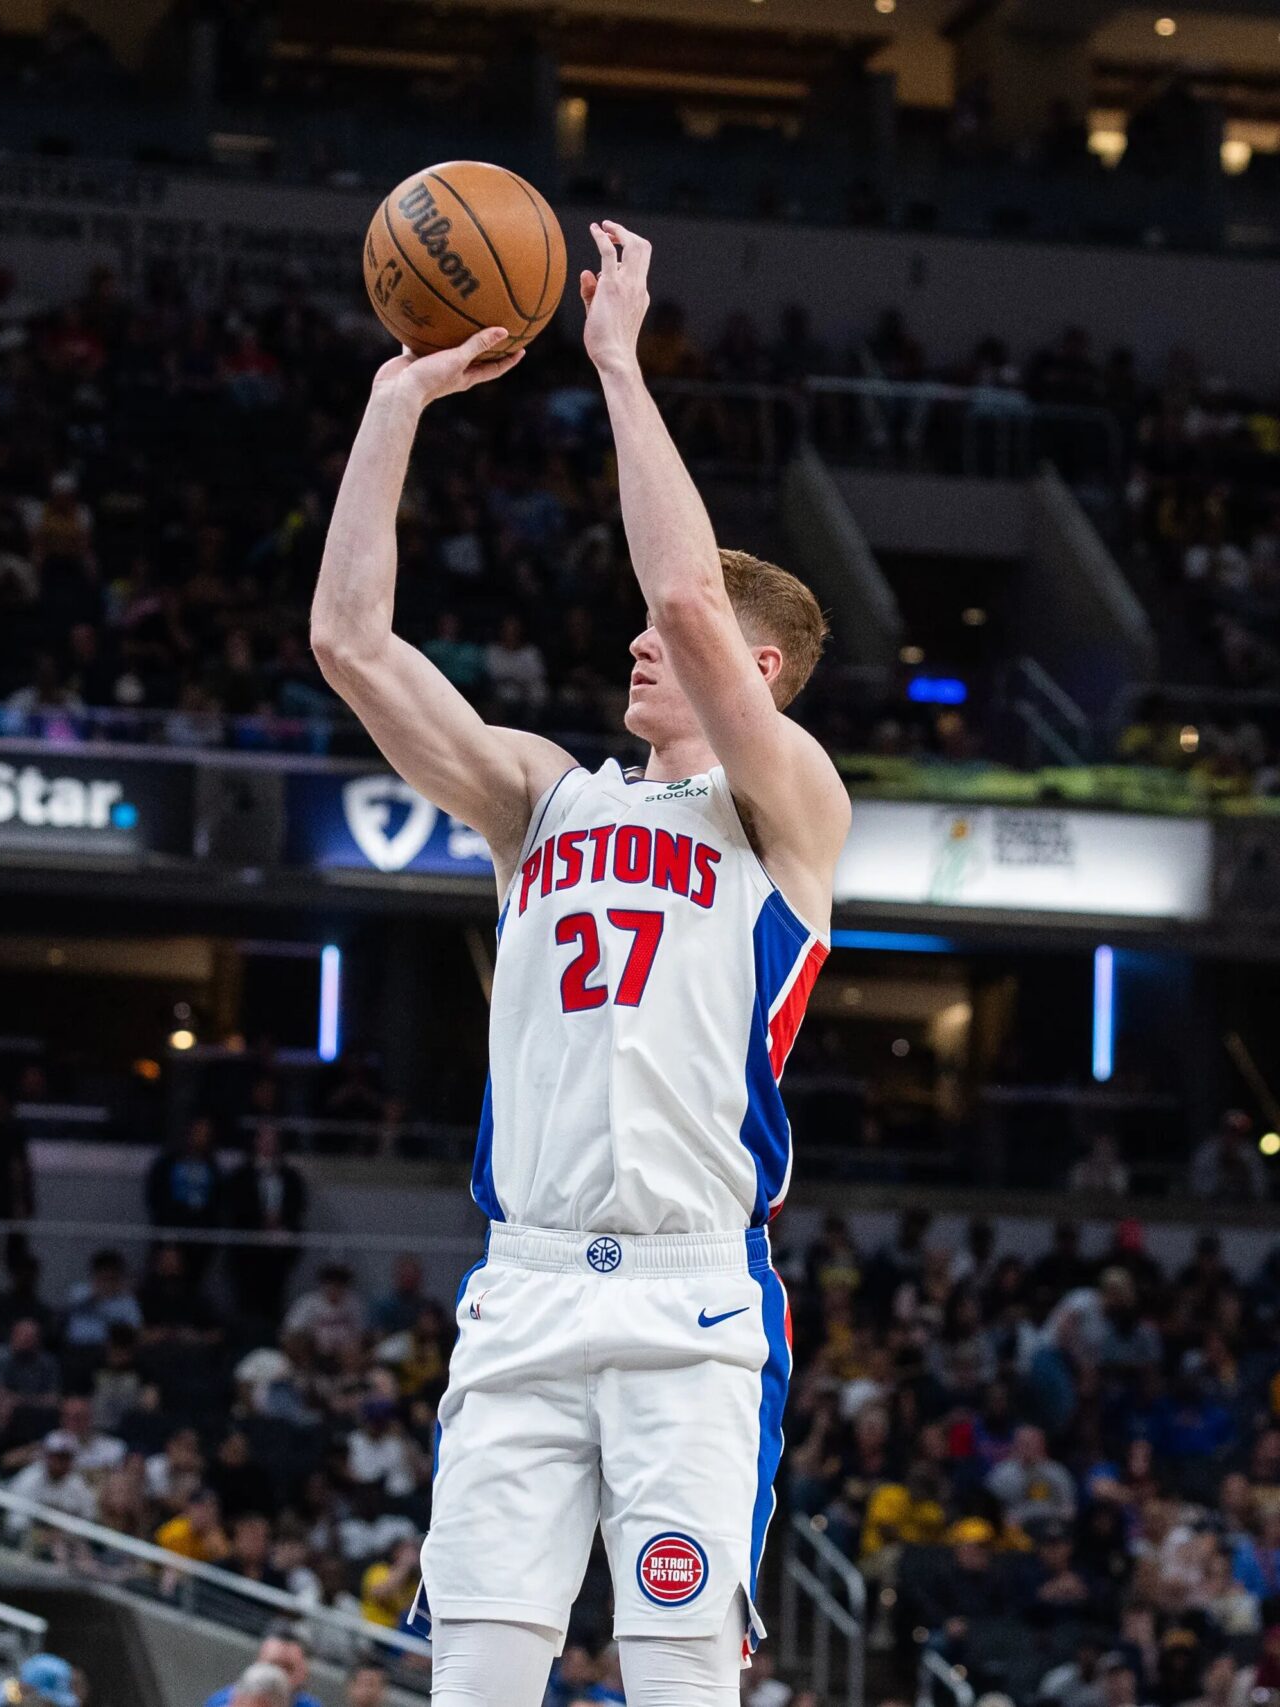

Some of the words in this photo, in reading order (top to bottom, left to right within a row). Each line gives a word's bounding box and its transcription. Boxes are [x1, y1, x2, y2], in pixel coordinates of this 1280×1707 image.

[398, 182, 480, 300] Wilson
[519, 823, 721, 917] PISTONS
[555, 909, 665, 1013] 27
[649, 1569, 694, 1582] PISTONS
[650, 1556, 694, 1570] DETROIT
